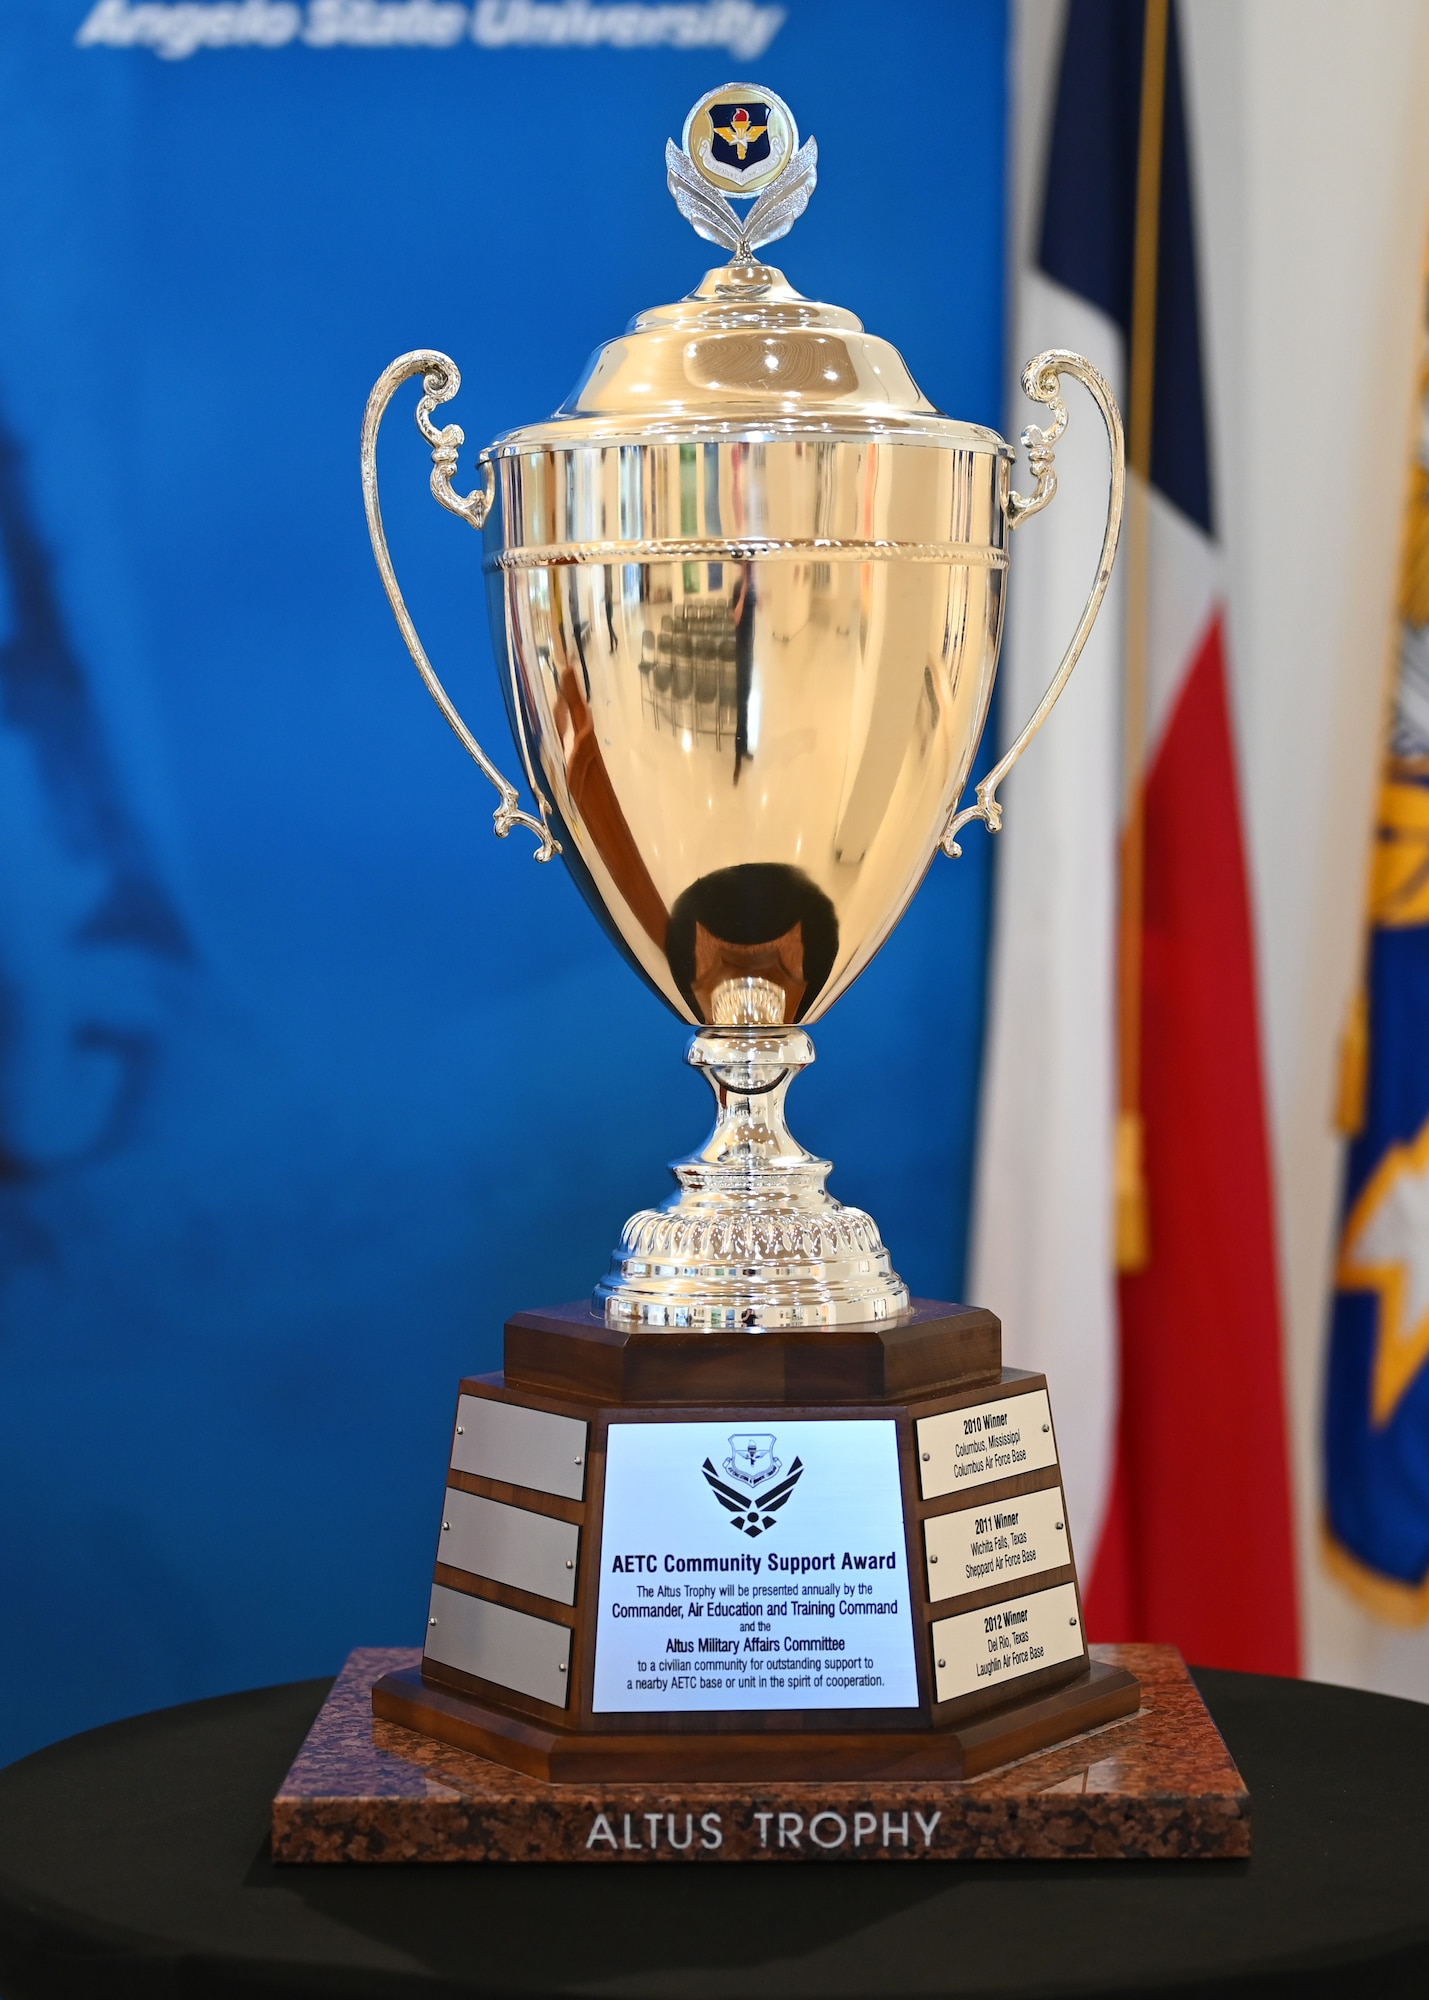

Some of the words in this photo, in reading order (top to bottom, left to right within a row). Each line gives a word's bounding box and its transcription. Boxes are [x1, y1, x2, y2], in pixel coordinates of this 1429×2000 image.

[302, 0, 467, 48] State
[964, 1417, 982, 1435] 2010
[983, 1413, 1008, 1430] Winner
[955, 1440, 988, 1457] Columbus,
[988, 1429, 1020, 1448] Mississippi
[953, 1457, 984, 1478] Columbus
[985, 1456, 994, 1470] Air
[995, 1453, 1011, 1467] Force
[1011, 1449, 1026, 1463] Base
[975, 1516, 993, 1534] 2011
[994, 1512, 1019, 1530] Winner
[970, 1538, 993, 1556] Wichita
[994, 1535, 1010, 1551] Falls,
[1011, 1532, 1027, 1546] Texas
[612, 1555, 657, 1573] AETC
[664, 1554, 761, 1575] Community
[768, 1553, 835, 1574] Support
[841, 1552, 895, 1569] Award
[965, 1559, 994, 1578] Sheppard
[995, 1557, 1004, 1570] Air
[1004, 1553, 1021, 1568] Force
[1021, 1549, 1036, 1563] Base
[637, 1586, 654, 1597] The
[657, 1585, 681, 1597] Altus
[684, 1585, 716, 1599] Trophy
[719, 1585, 734, 1596] will
[738, 1585, 749, 1596] be
[753, 1584, 798, 1598] presented
[802, 1584, 840, 1597] annually
[844, 1583, 855, 1597] by
[858, 1583, 872, 1594] the
[612, 1603, 683, 1619] Commander,
[688, 1603, 704, 1617] Air
[707, 1602, 762, 1616] Education
[767, 1602, 787, 1616] and
[791, 1601, 835, 1618] Training
[839, 1600, 897, 1615] Command
[984, 1614, 1002, 1633] 2012
[1003, 1608, 1028, 1627] Winner
[740, 1622, 755, 1632] and
[758, 1621, 770, 1631] the
[666, 1639, 694, 1653] Altus
[698, 1638, 739, 1655] Military
[744, 1637, 780, 1652] Affairs
[784, 1637, 845, 1651] Committee
[987, 1638, 998, 1652] Del
[999, 1635, 1011, 1650] Rio,
[1012, 1631, 1029, 1645] Texas
[638, 1661, 647, 1671] to
[650, 1662, 655, 1671] a
[659, 1659, 691, 1671] civilian
[695, 1659, 747, 1672] community
[751, 1659, 763, 1670] for
[767, 1658, 821, 1671] outstanding
[825, 1658, 861, 1671] support
[864, 1658, 873, 1668] to
[976, 1659, 1001, 1676] Laughlin
[1002, 1653, 1012, 1667] Air
[1012, 1650, 1029, 1664] Force
[1029, 1646, 1044, 1660] Base
[627, 1680, 632, 1689] a
[636, 1678, 668, 1691] nearby
[671, 1677, 696, 1688] AETC
[700, 1677, 722, 1688] base
[726, 1679, 735, 1688] or
[739, 1676, 756, 1688] unit
[759, 1676, 767, 1687] in
[770, 1676, 784, 1687] the
[788, 1676, 811, 1689] spirit
[814, 1675, 823, 1687] of
[826, 1674, 884, 1688] cooperation.
[585, 1813, 723, 1850] ALTUS
[753, 1811, 942, 1848] TROPHY
